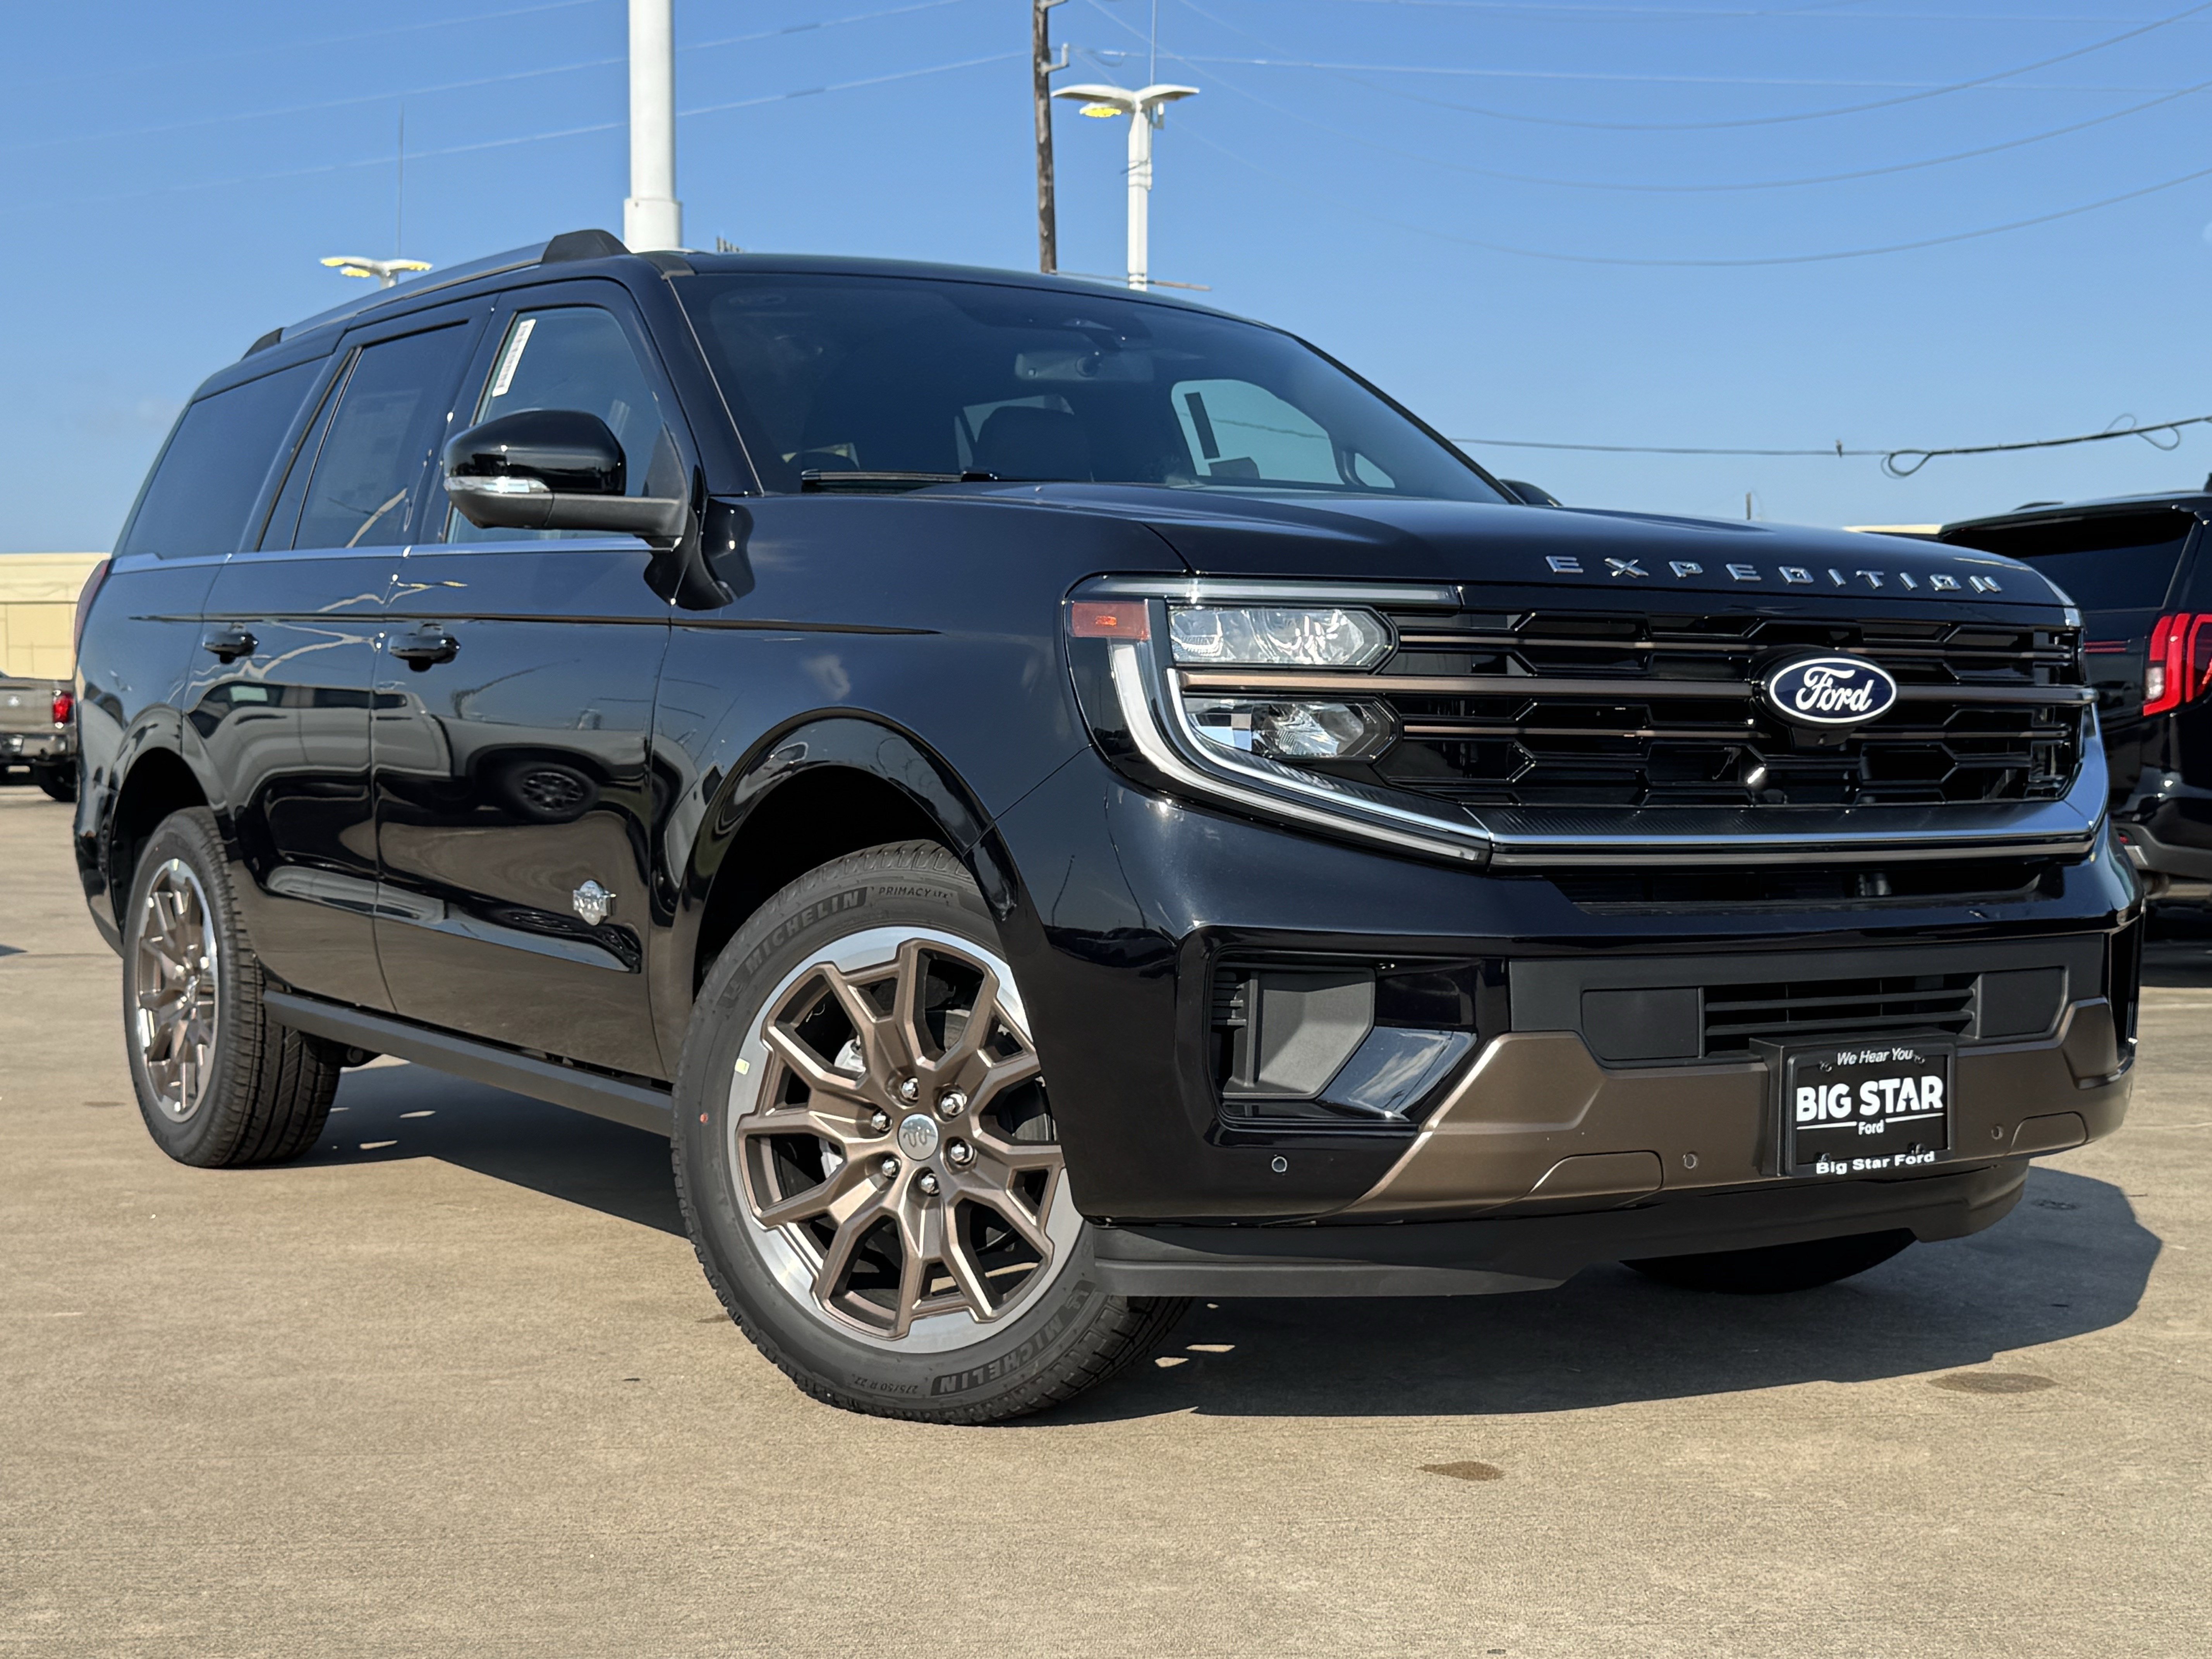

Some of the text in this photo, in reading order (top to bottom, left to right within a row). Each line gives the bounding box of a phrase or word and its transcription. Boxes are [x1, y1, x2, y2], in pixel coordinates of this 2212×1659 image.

[1546, 555, 2002, 592] EXPEDITION
[1796, 666, 1875, 712] Ford
[879, 886, 931, 897] PRIMACY
[745, 891, 858, 975] MICHELIN
[1837, 1048, 1913, 1066] We Hear You
[1796, 1075, 1943, 1122] BIG STAR
[1858, 1120, 1884, 1135] Ford
[1816, 1151, 1935, 1175] Big Star Ford
[940, 1314, 1064, 1393] MICHELIN
[880, 1383, 918, 1394] 275/50
